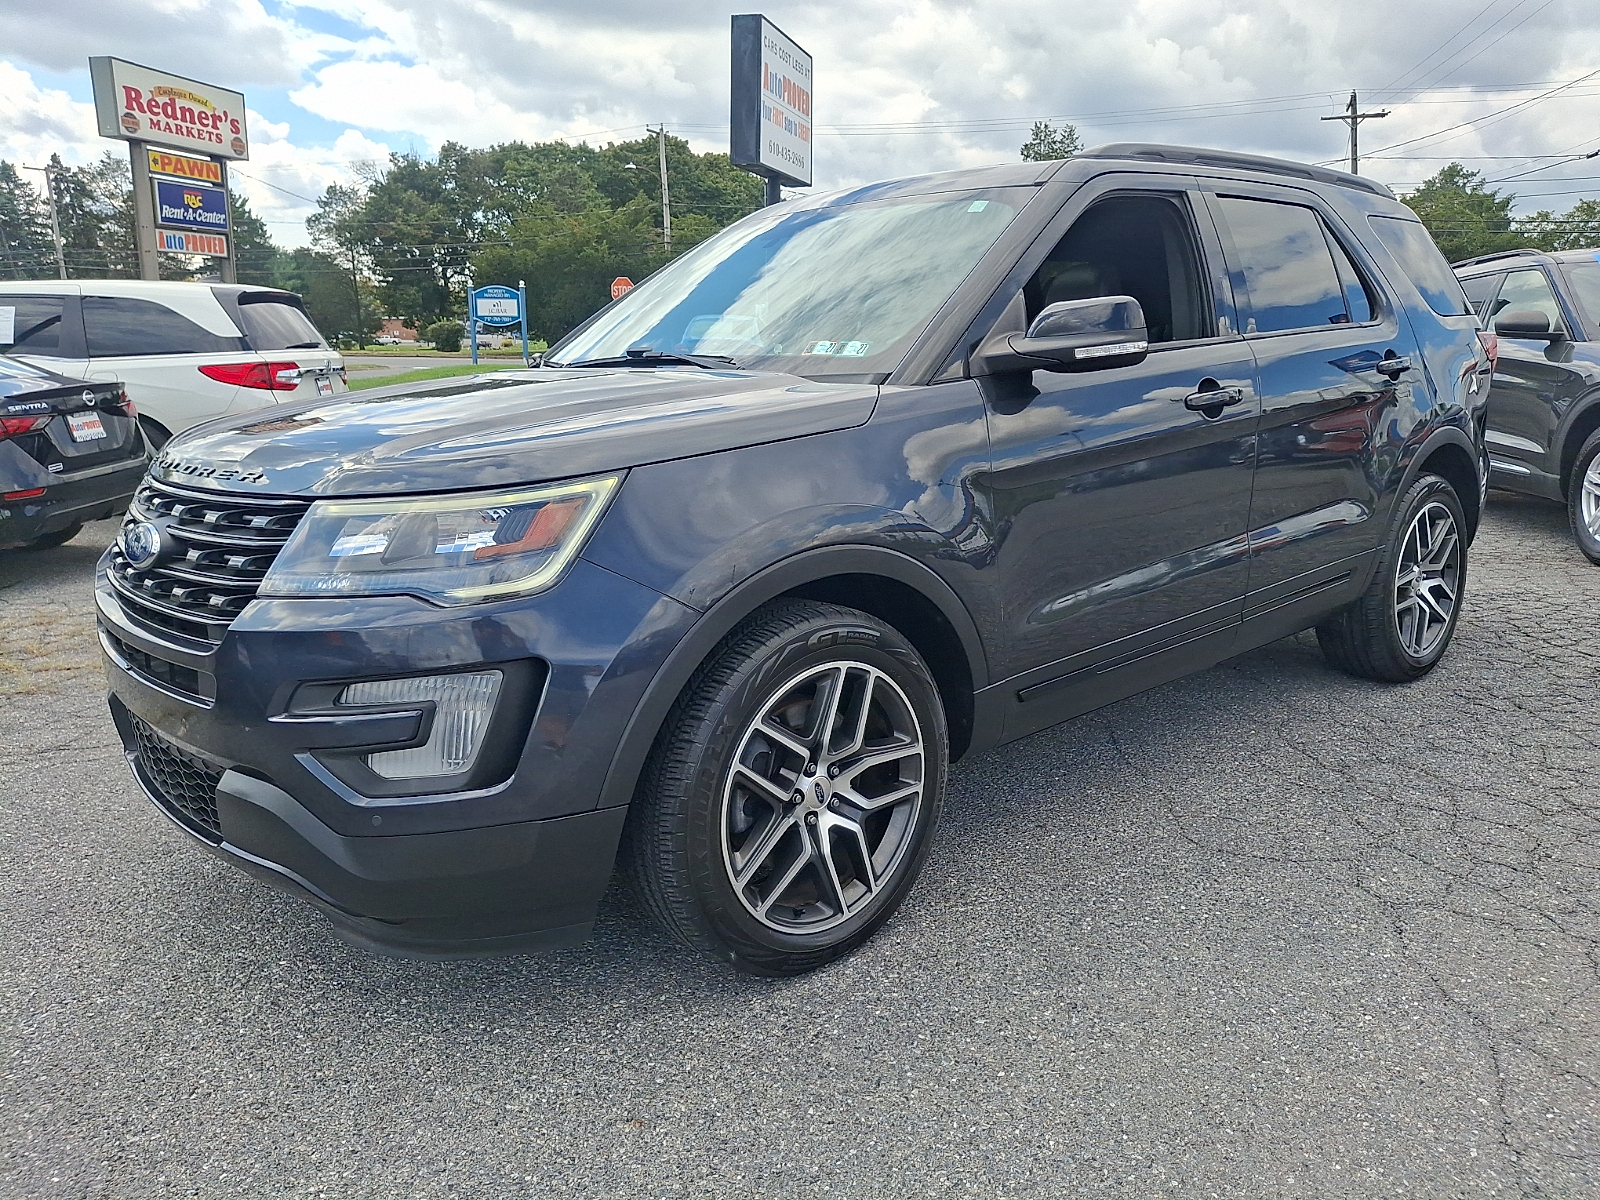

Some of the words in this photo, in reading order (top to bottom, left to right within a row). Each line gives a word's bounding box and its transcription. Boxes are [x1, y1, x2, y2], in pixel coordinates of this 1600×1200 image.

[778, 46, 791, 67] COST
[792, 56, 804, 76] LESS
[157, 86, 187, 100] Employee
[188, 93, 209, 108] Owned
[763, 61, 810, 117] AutoPROVED
[122, 85, 241, 136] Redner's
[149, 117, 223, 145] MARKETS
[159, 154, 220, 182] PAWN
[158, 231, 225, 255] AutoPROVED
[7, 402, 49, 413] SENTRA
